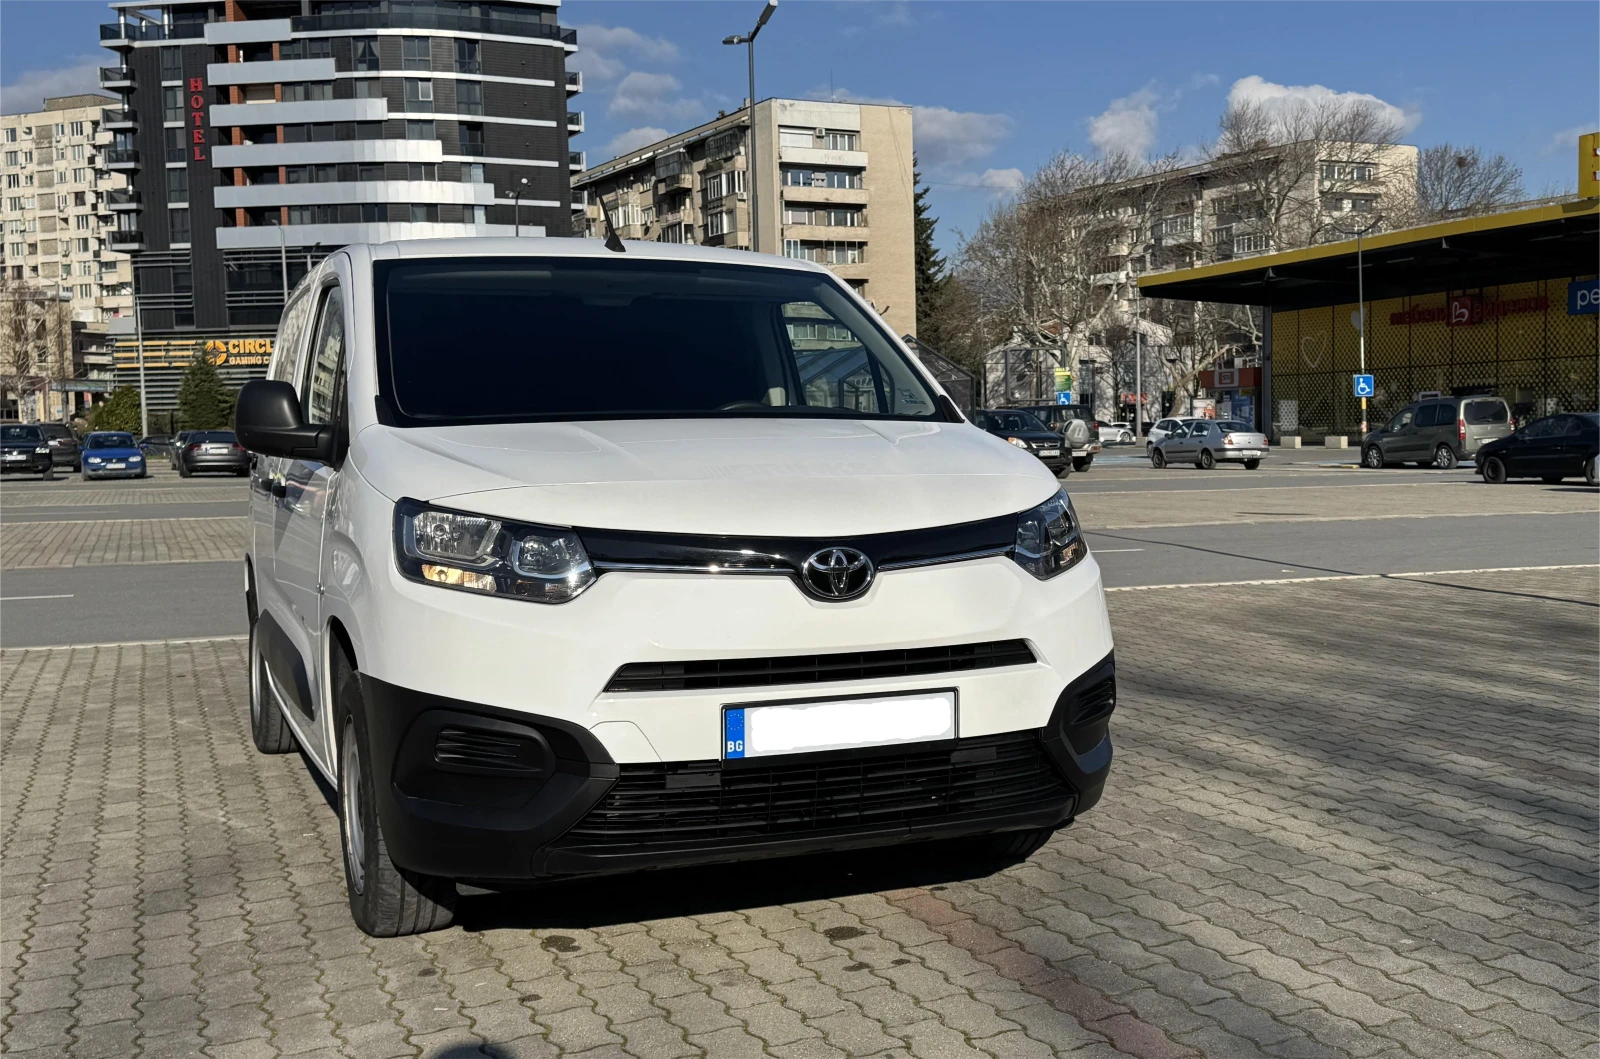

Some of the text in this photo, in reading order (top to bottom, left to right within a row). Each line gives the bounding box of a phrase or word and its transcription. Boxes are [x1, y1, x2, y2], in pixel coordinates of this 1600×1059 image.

[189, 77, 206, 161] HOTEL
[1577, 288, 1600, 310] pe
[229, 355, 262, 365] GAMING
[727, 740, 744, 753] BG
